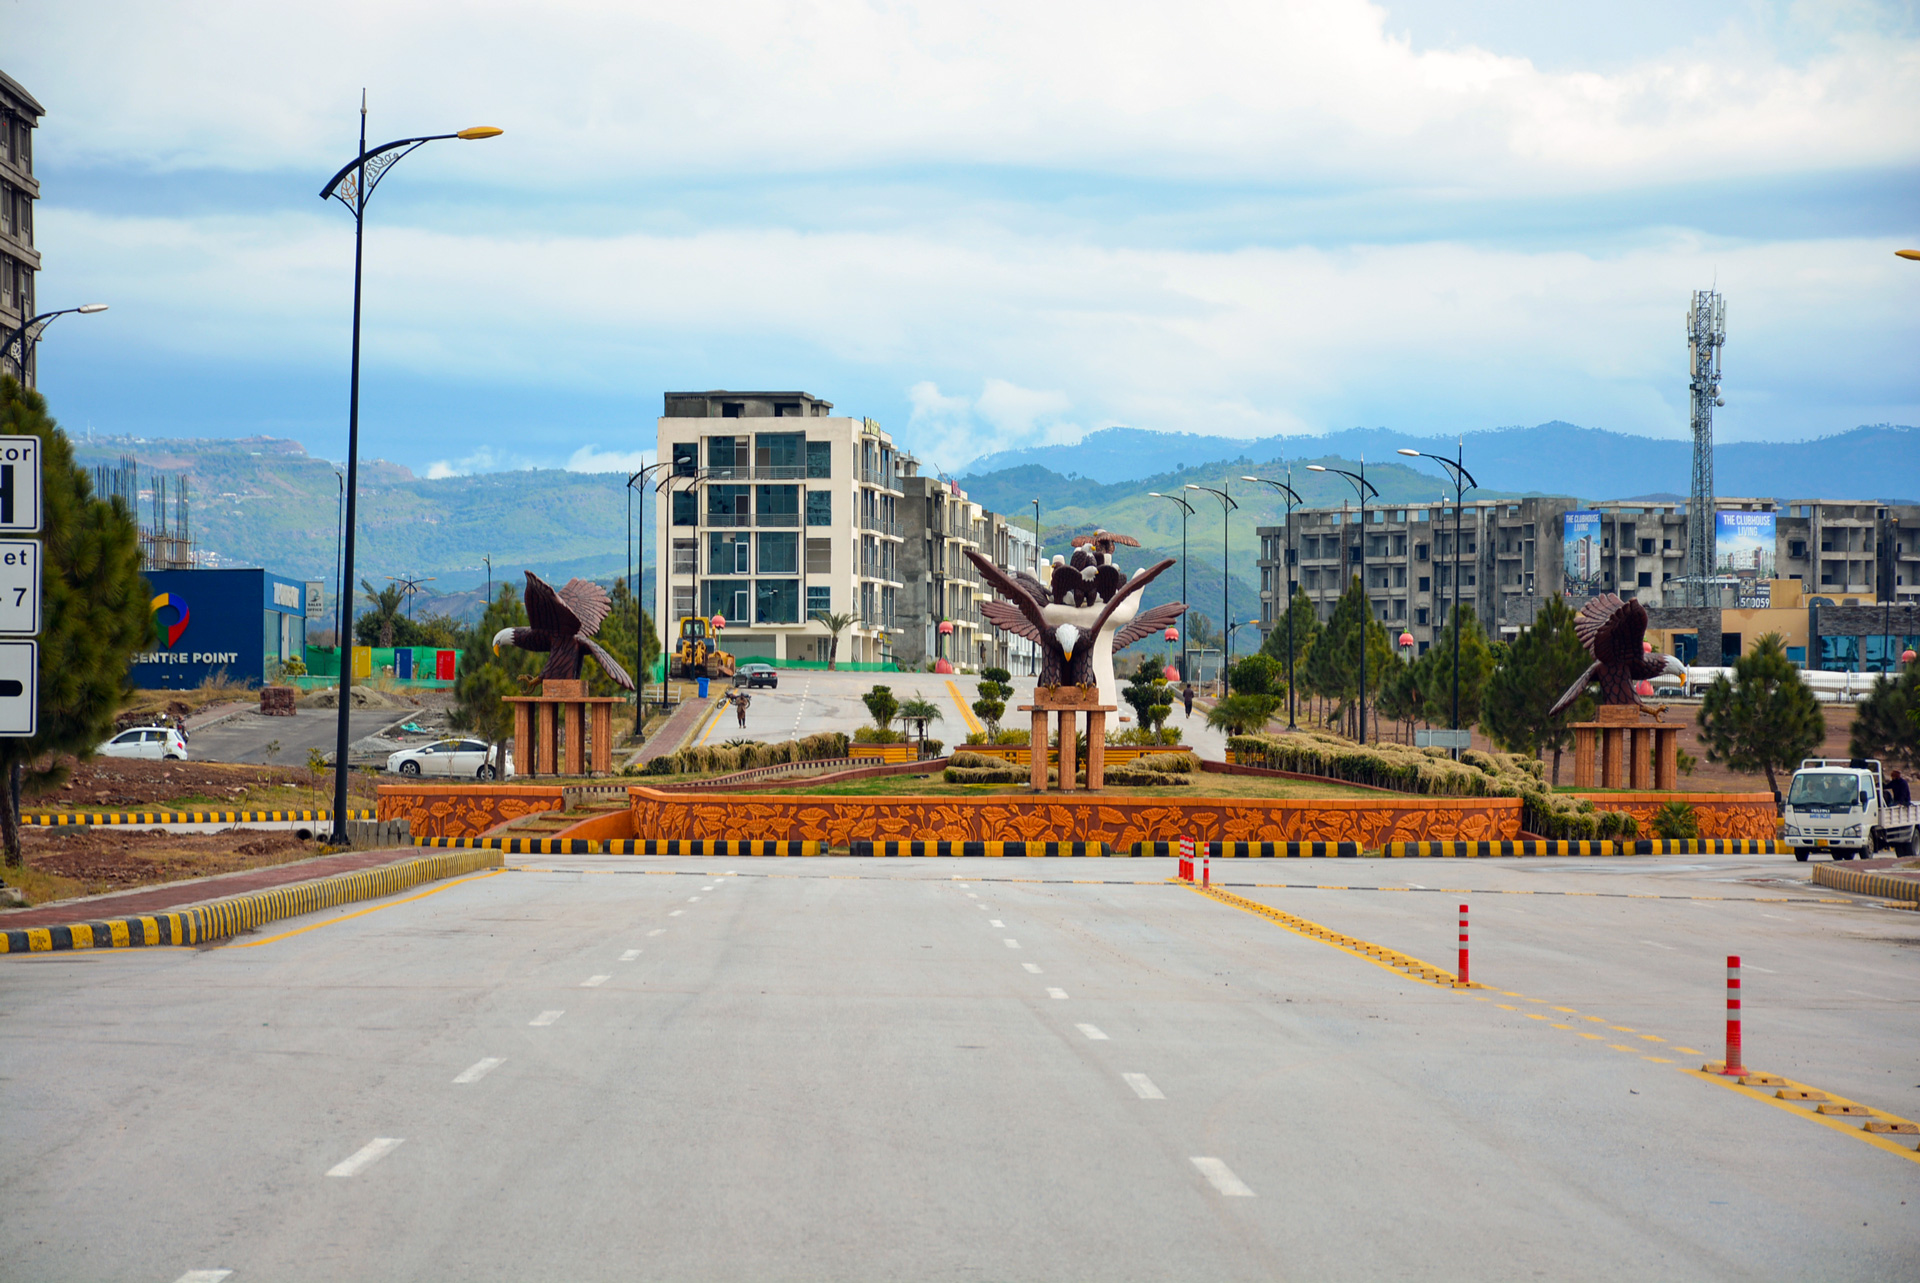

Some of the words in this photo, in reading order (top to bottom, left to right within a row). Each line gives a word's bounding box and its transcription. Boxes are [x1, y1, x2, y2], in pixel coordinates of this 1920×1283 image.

[0, 448, 31, 461] or
[1723, 514, 1736, 525] THE
[1736, 514, 1771, 526] CLUBHOUSE
[1737, 526, 1758, 537] LIVING
[13, 587, 27, 607] 7
[130, 652, 189, 664] CENTRE
[192, 652, 238, 664] POINT
